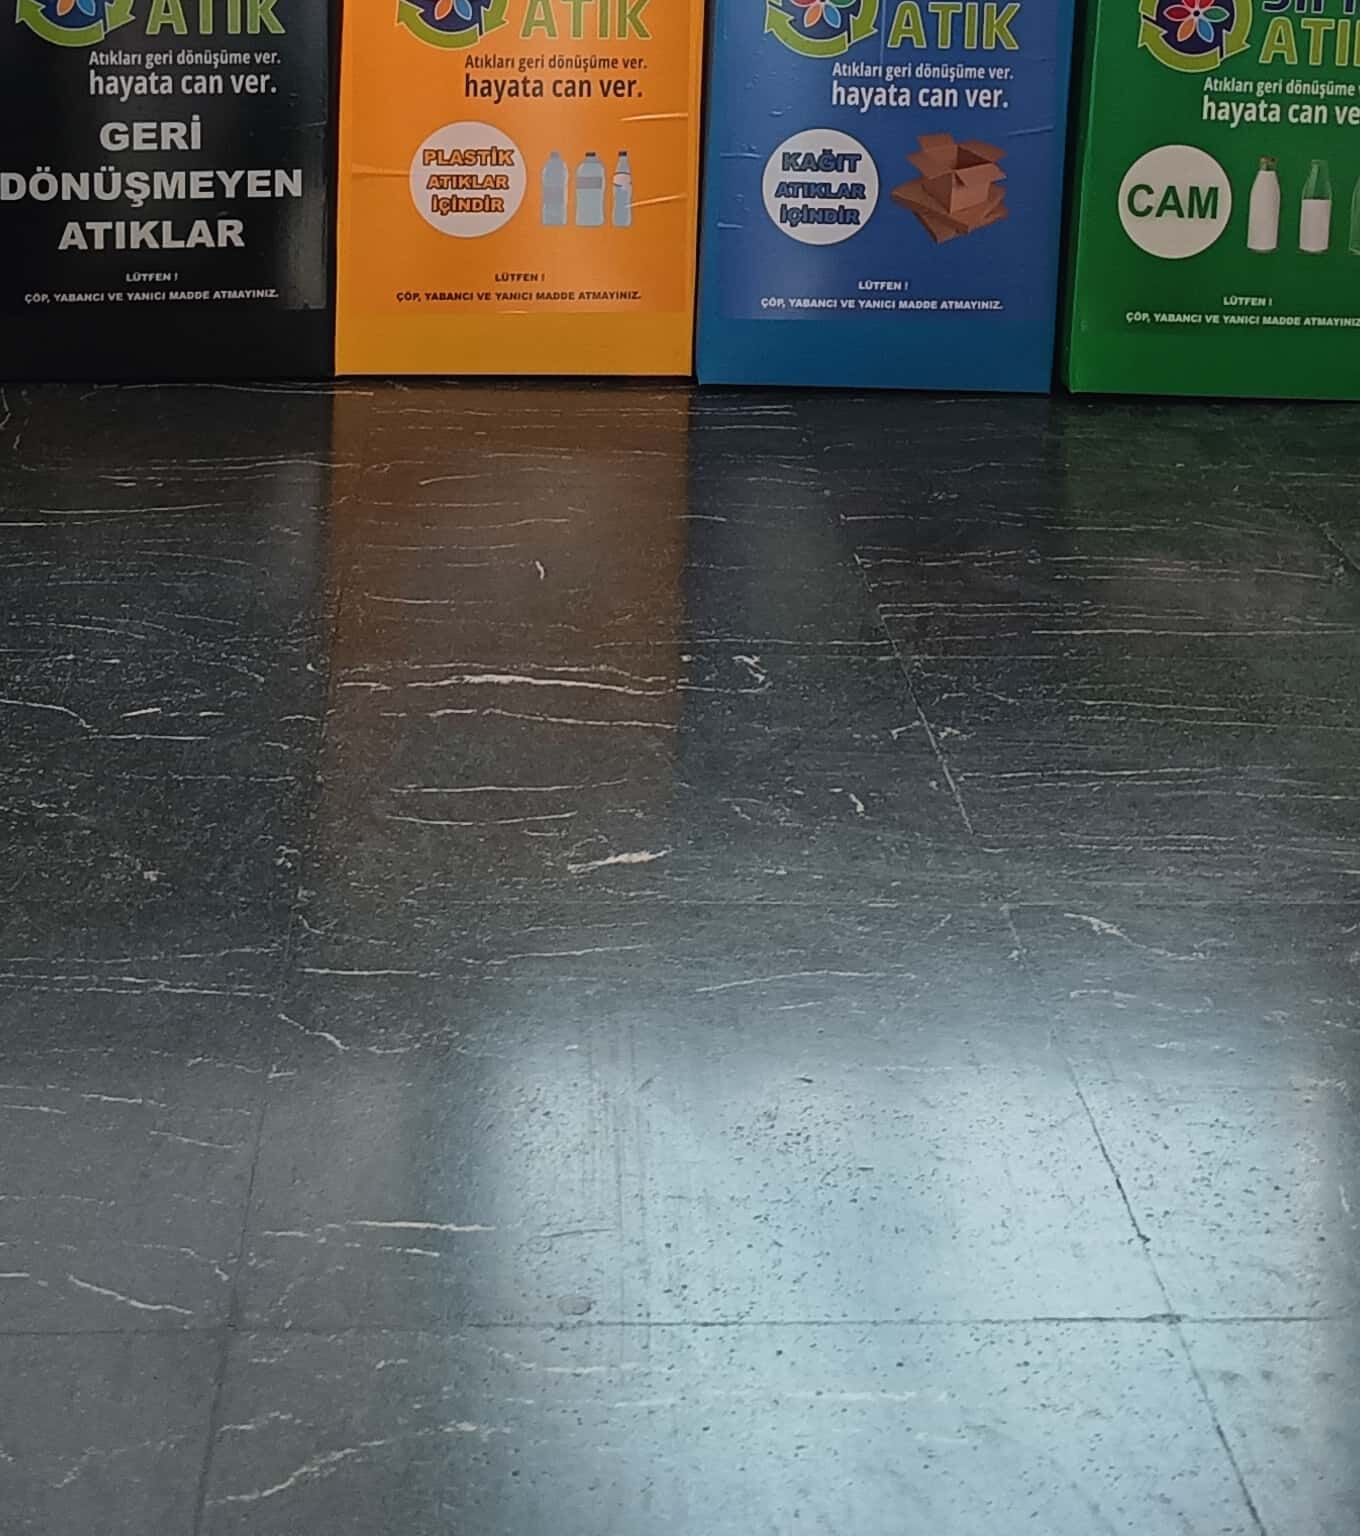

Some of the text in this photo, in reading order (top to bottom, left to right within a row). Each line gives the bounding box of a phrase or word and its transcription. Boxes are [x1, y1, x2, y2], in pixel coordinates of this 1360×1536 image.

[888, 2, 1021, 50] ATIK
[89, 50, 281, 69] Atıkları geri dönüşüme ver.
[465, 54, 648, 72] Atıkları geri dönüşüme ver.
[832, 63, 1014, 82] Atıkları geri dönüşüme ver.
[89, 70, 277, 101] hayata can ver.
[465, 73, 643, 104] hayata can ver.
[1204, 77, 1253, 93] Atıkları
[1256, 78, 1282, 96] geri
[1285, 79, 1356, 99] dönüşüme
[832, 82, 1009, 112] hayata can ver.
[1202, 95, 1281, 128] hayata
[1288, 102, 1328, 124] can
[100, 114, 201, 152] GERİ
[423, 145, 515, 166] PLASTİK
[782, 149, 862, 172] KAĞIT
[0, 166, 303, 208] DÖNÜŞMEYEN
[426, 174, 509, 190] ATIKLAR
[775, 182, 866, 200] ATIKLAR
[431, 194, 504, 215] İÇİNDİR
[1127, 184, 1219, 219] CAM
[779, 204, 860, 226] İÇİNDİR
[58, 219, 245, 250] ATIKLAR
[126, 272, 171, 282] LÜTFEN
[495, 272, 538, 282] LÜTFEN
[858, 280, 902, 290] LÜTFEN
[54, 293, 105, 302] YABANCI
[107, 293, 123, 301] VE
[126, 291, 166, 301] YANICI
[169, 291, 209, 300] MADDE
[425, 292, 474, 301] YABANCI
[477, 292, 491, 301] VE
[496, 292, 533, 301] YANICI
[536, 292, 575, 300] MADDE
[788, 299, 838, 308] YABANCI
[840, 299, 855, 308] VE
[858, 299, 896, 309] YANICI
[899, 300, 937, 309] MADDE
[1224, 296, 1266, 306] LÜTFEN
[1154, 314, 1202, 323] YABANCI
[1205, 314, 1219, 323] VE
[1223, 315, 1259, 324] YANICI
[1262, 316, 1301, 325] MADDE
